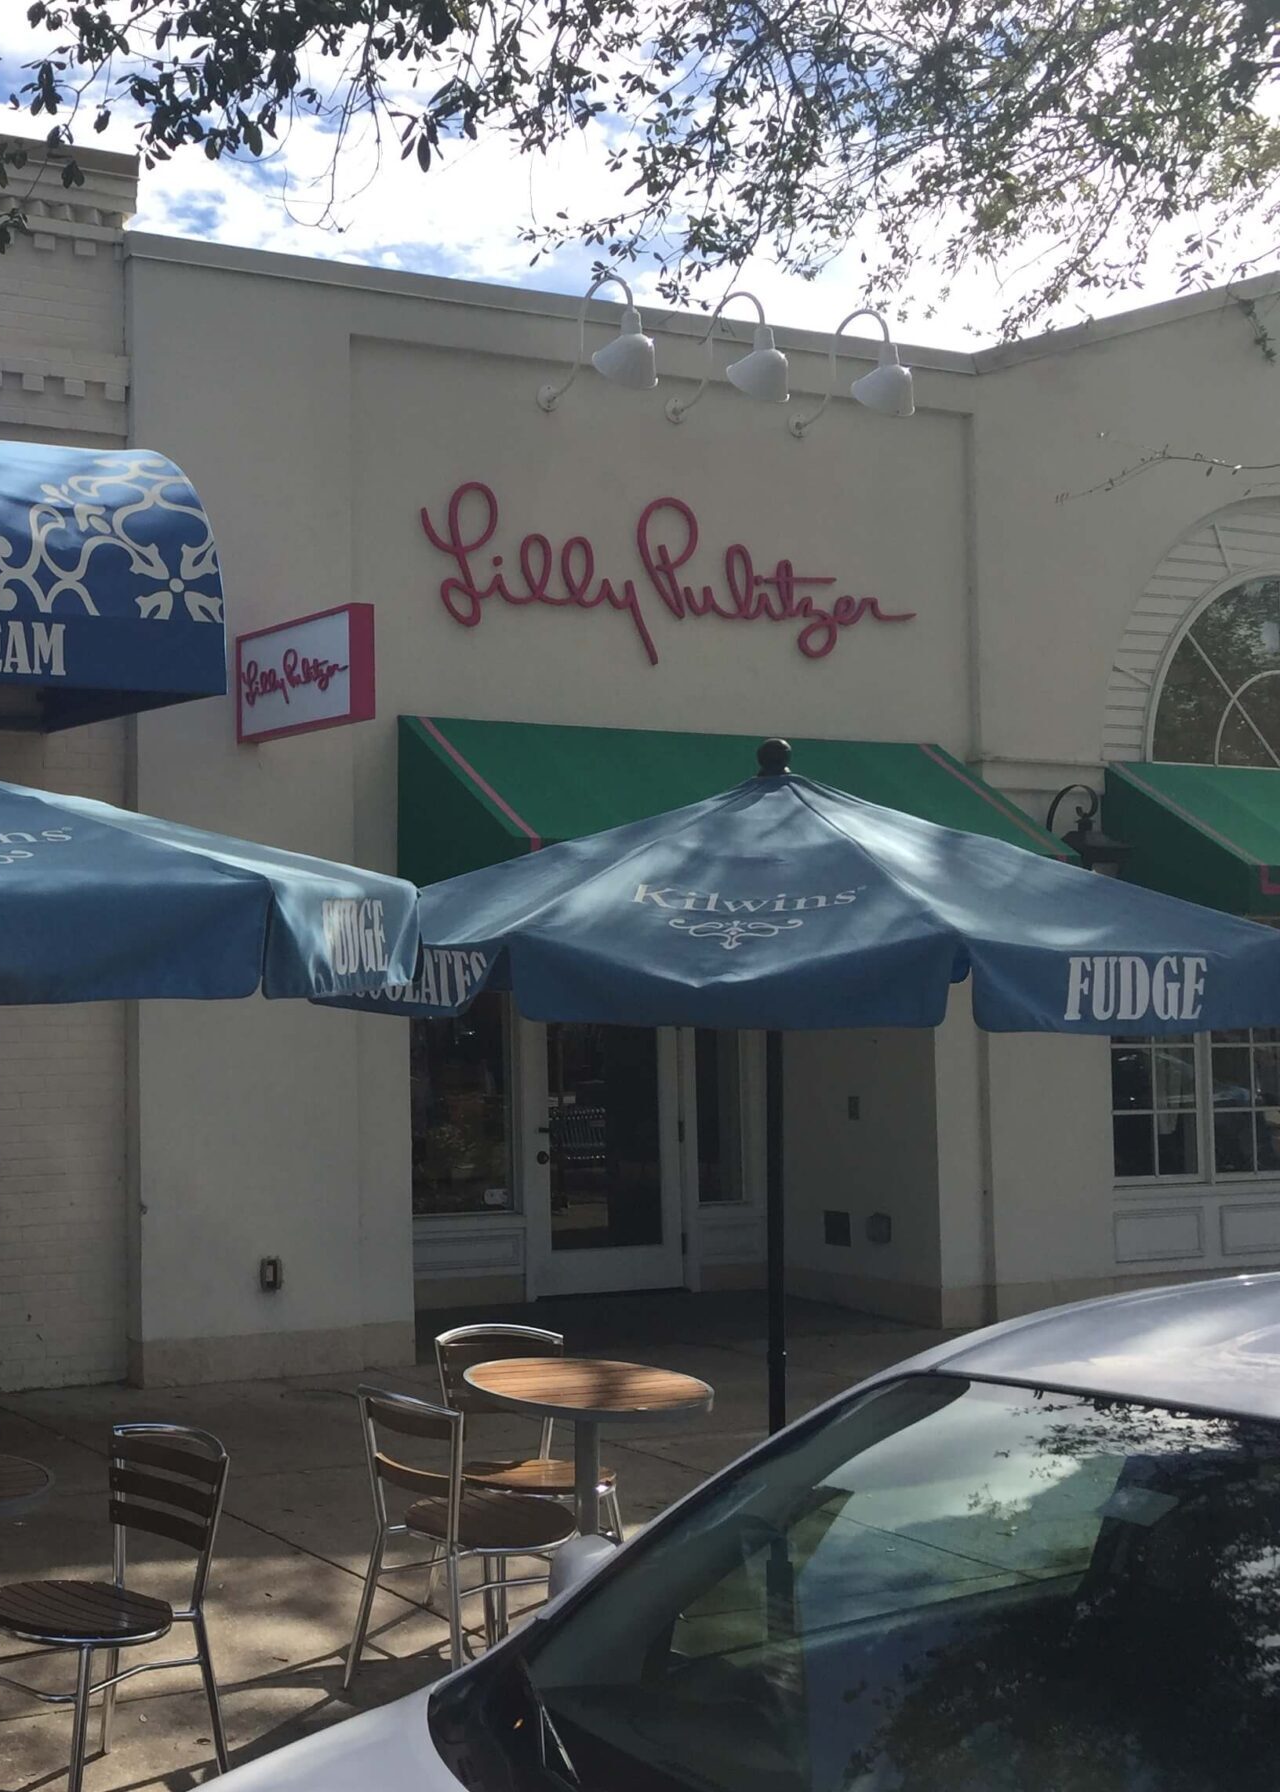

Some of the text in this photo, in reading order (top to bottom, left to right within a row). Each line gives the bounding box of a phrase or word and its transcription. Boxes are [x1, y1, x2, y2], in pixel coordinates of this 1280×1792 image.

[420, 481, 917, 666] Lilly Pulitzer
[242, 660, 290, 707] Lilly
[322, 899, 390, 976] FUDGE
[1063, 955, 1208, 1021] FUDGE
